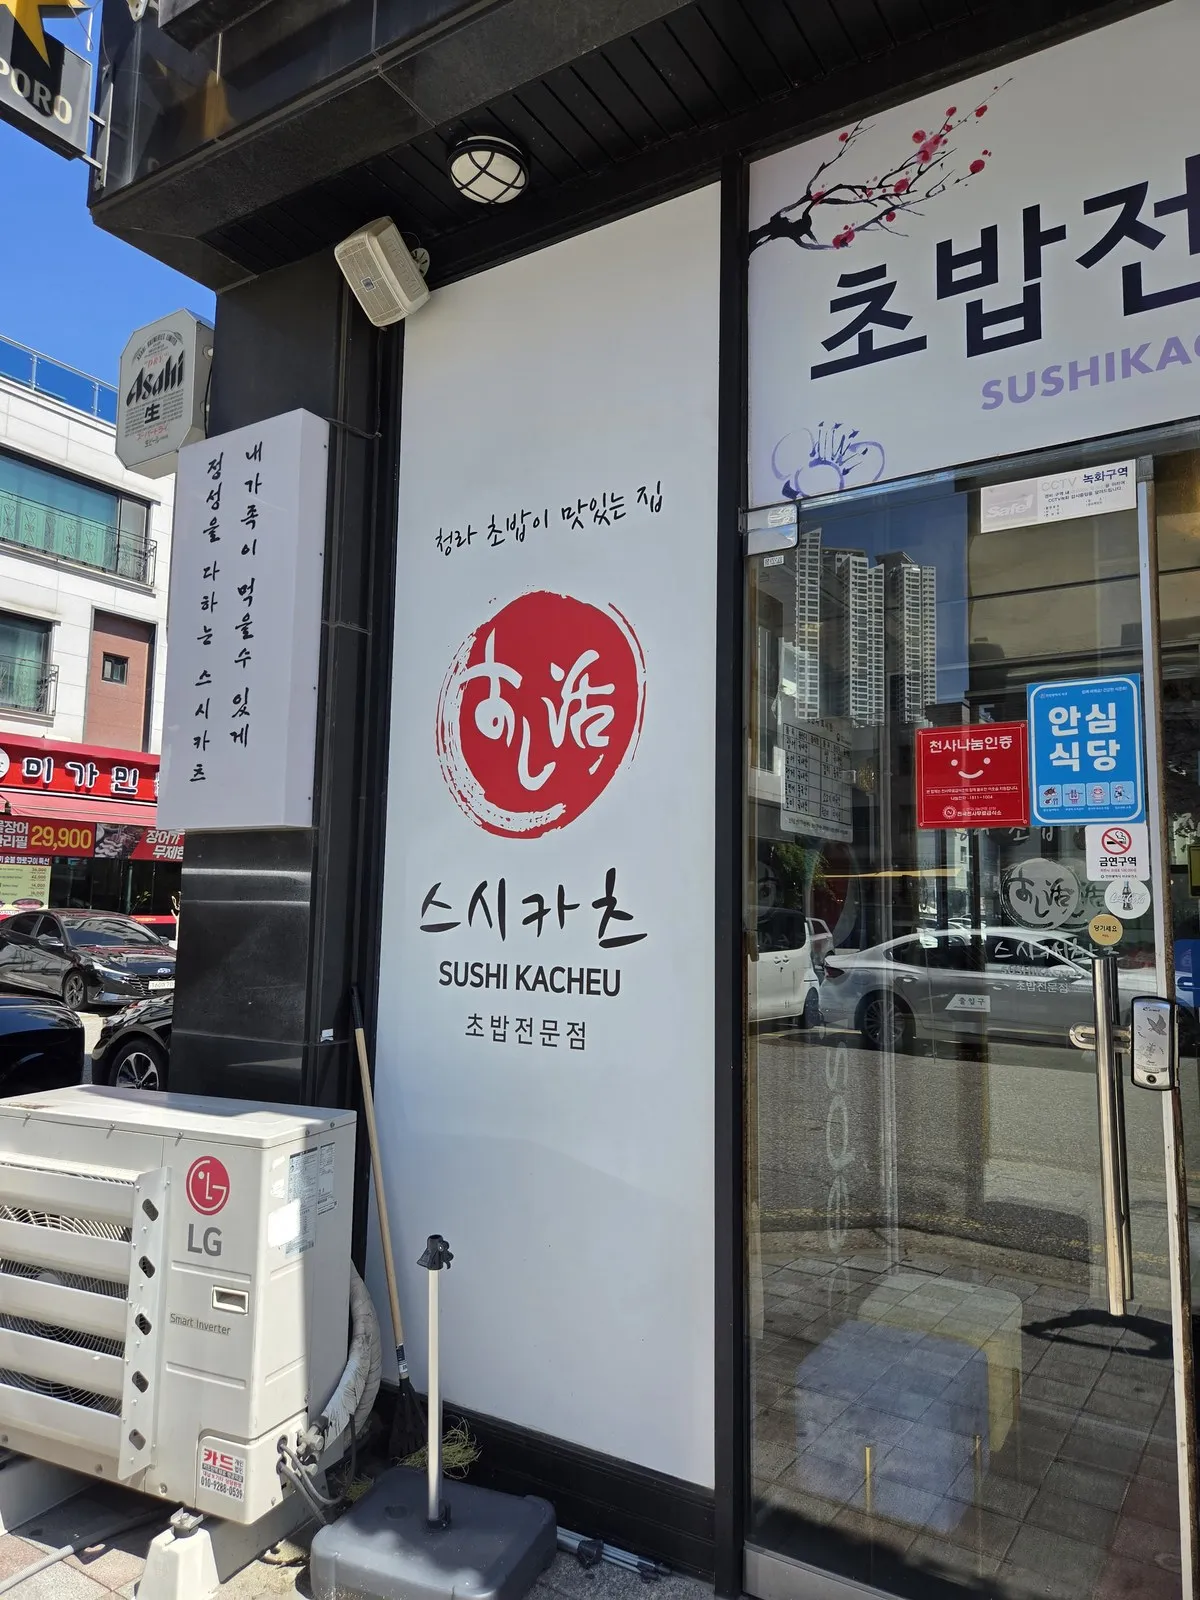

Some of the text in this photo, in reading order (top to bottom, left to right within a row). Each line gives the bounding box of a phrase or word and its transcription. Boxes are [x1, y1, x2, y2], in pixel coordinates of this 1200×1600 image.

[126, 351, 184, 407] Asahi
[144, 403, 160, 424] 生
[1041, 477, 1077, 492] CCTV
[1082, 466, 1128, 484] 녹화구역
[239, 440, 263, 557] 내가족이
[434, 480, 664, 556] 청라 초밥이 맛있는 집
[189, 451, 224, 782] 정성을 다하는 스시카츠
[229, 686, 251, 748] 있게
[1048, 702, 1117, 737] 안심
[929, 735, 1013, 754] 천사나눔인증
[1049, 739, 1120, 772] 식당
[22, 757, 160, 796] 미가민
[31, 826, 92, 850] 29,900
[1099, 857, 1137, 866] 금연구역
[419, 867, 648, 949] 스시카츠
[1093, 924, 1118, 932] 당기세요
[438, 960, 621, 997] SUSHI KACHEU
[465, 1013, 587, 1051] 초밥전문점
[187, 1223, 223, 1257] LG
[170, 1313, 231, 1336] Smart Inverter
[204, 1448, 233, 1471] 카드
